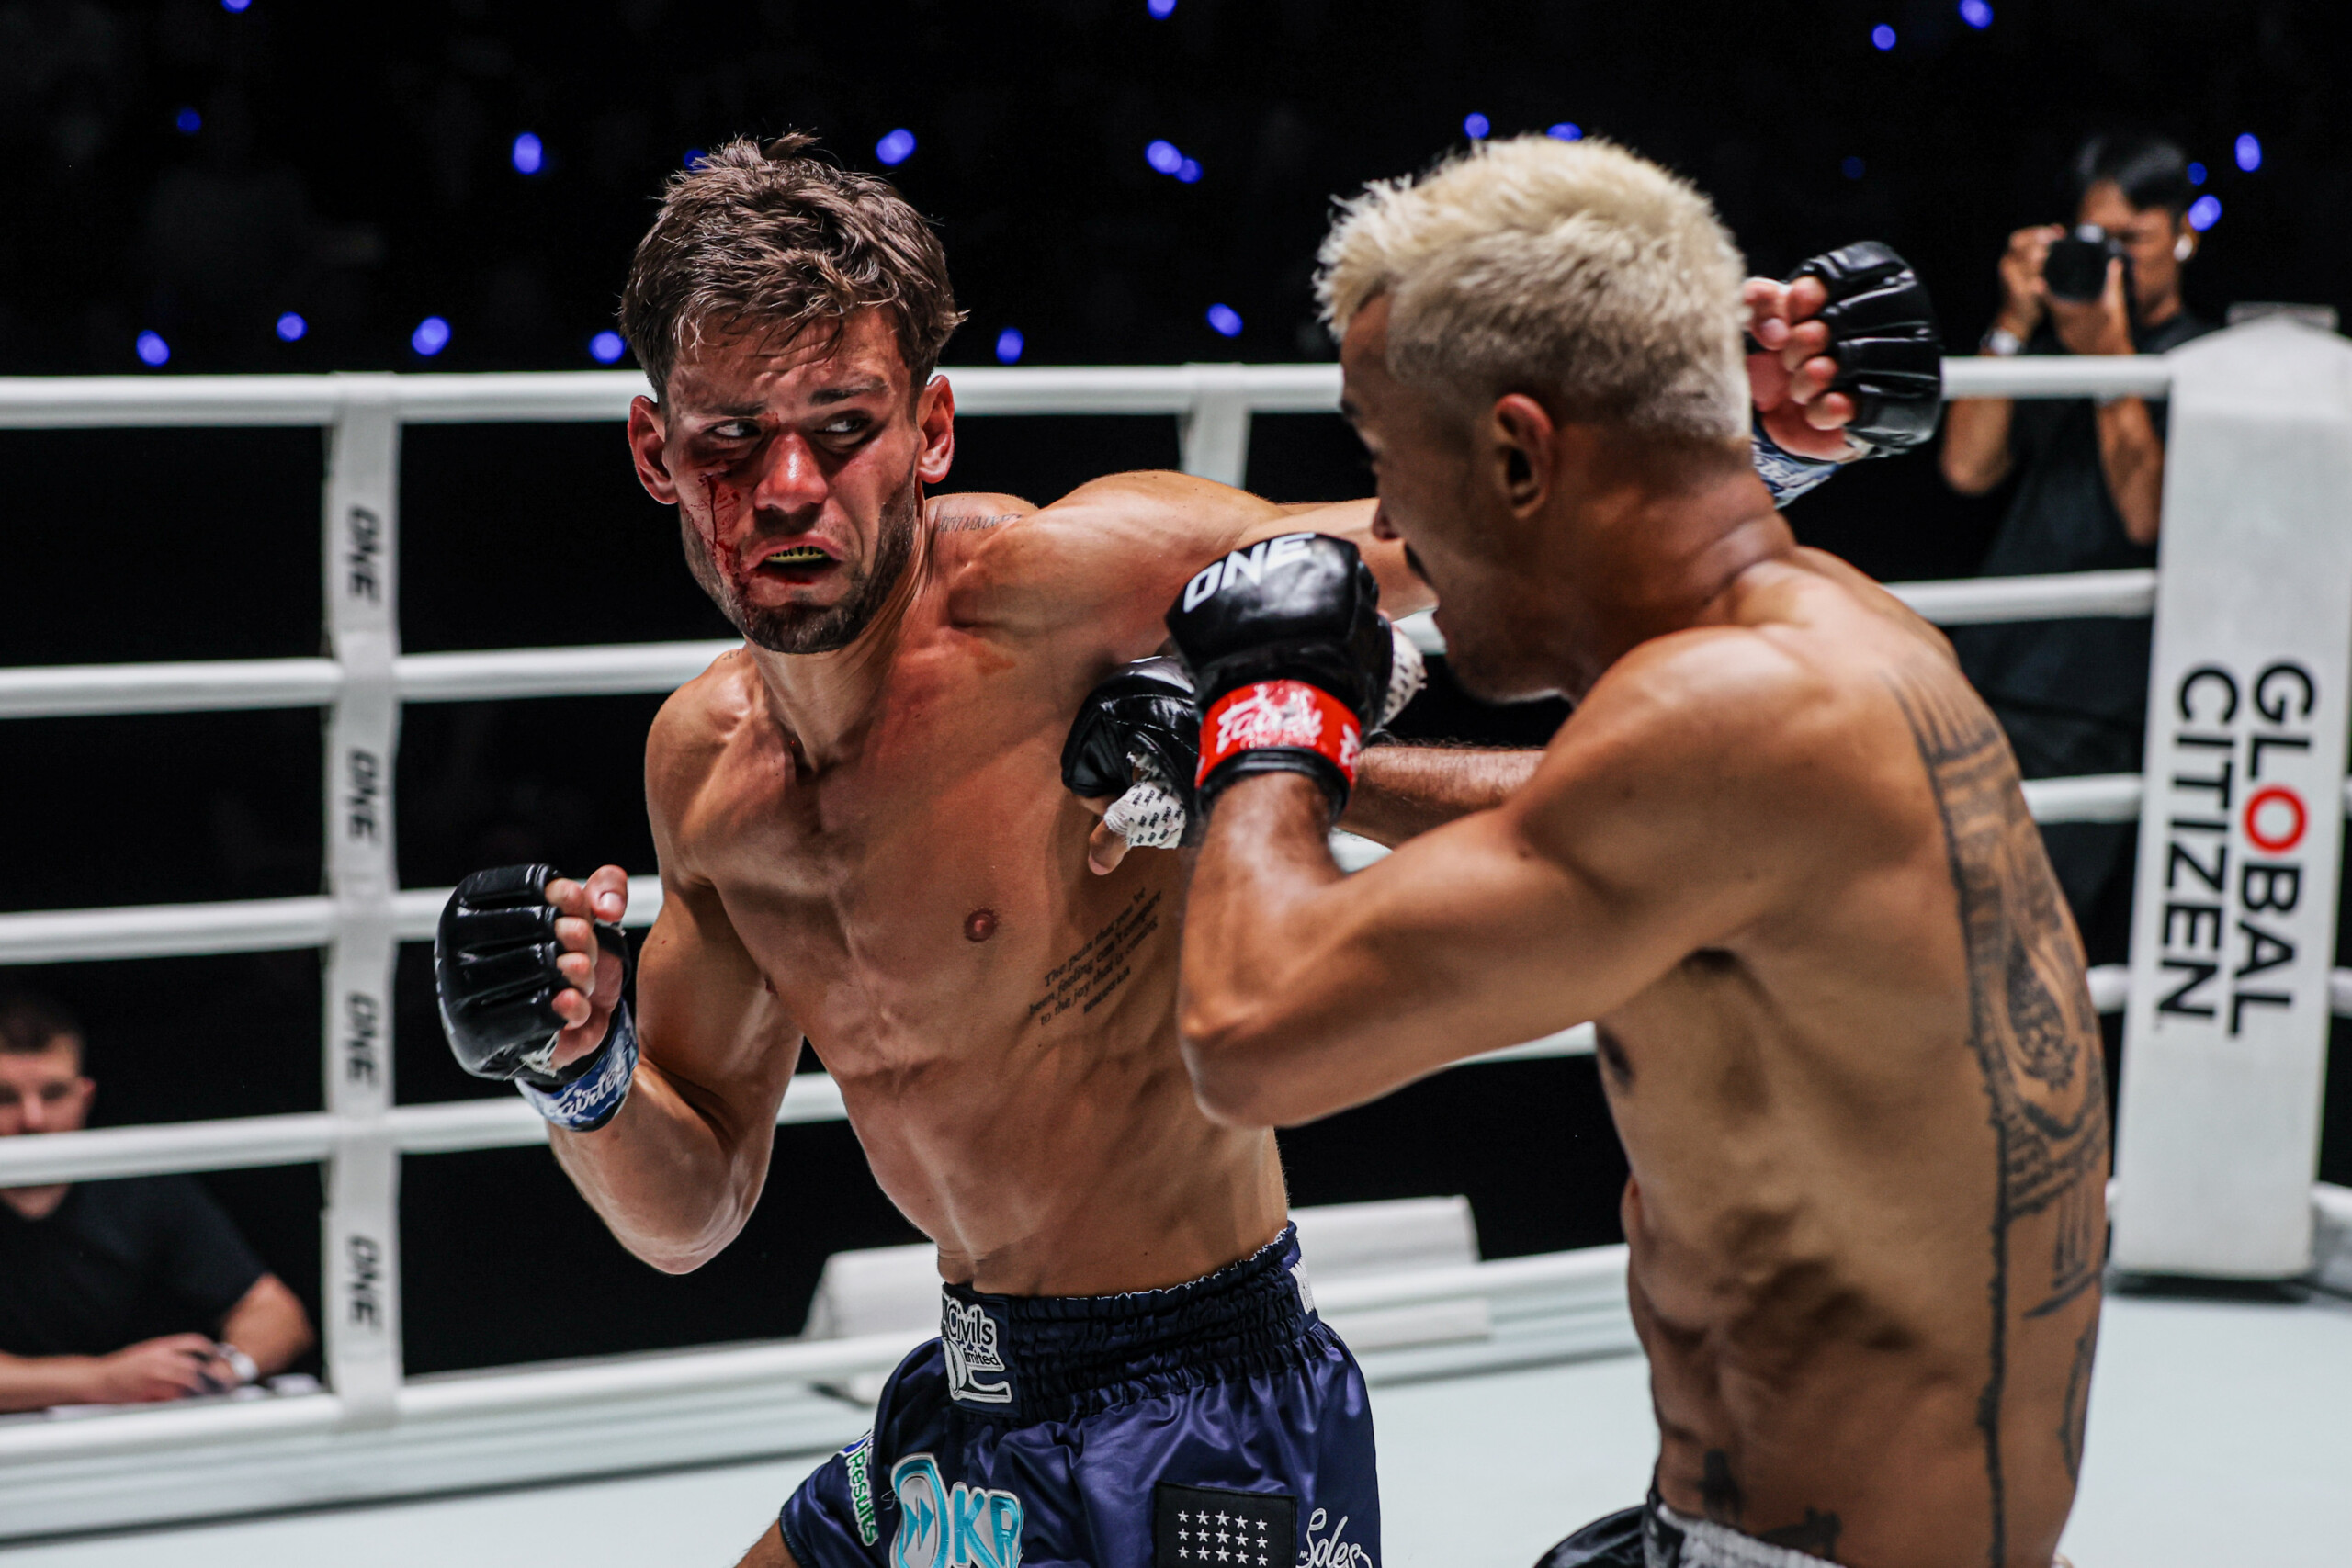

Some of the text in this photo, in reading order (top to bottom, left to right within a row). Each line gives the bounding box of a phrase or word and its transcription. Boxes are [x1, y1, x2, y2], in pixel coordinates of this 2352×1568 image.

[346, 504, 382, 605] ONE
[1182, 532, 1316, 614] ONE
[346, 749, 381, 846] ONE
[2156, 664, 2239, 1020] CITIZEN
[2228, 660, 2316, 1038] GLOBAL
[345, 992, 380, 1089] ONE
[1040, 1012, 1052, 1026] to
[1054, 998, 1071, 1016] the
[1071, 981, 1091, 1007] joy
[346, 1235, 382, 1335] ONE
[948, 1304, 994, 1345] Civils
[849, 1450, 879, 1544] Results
